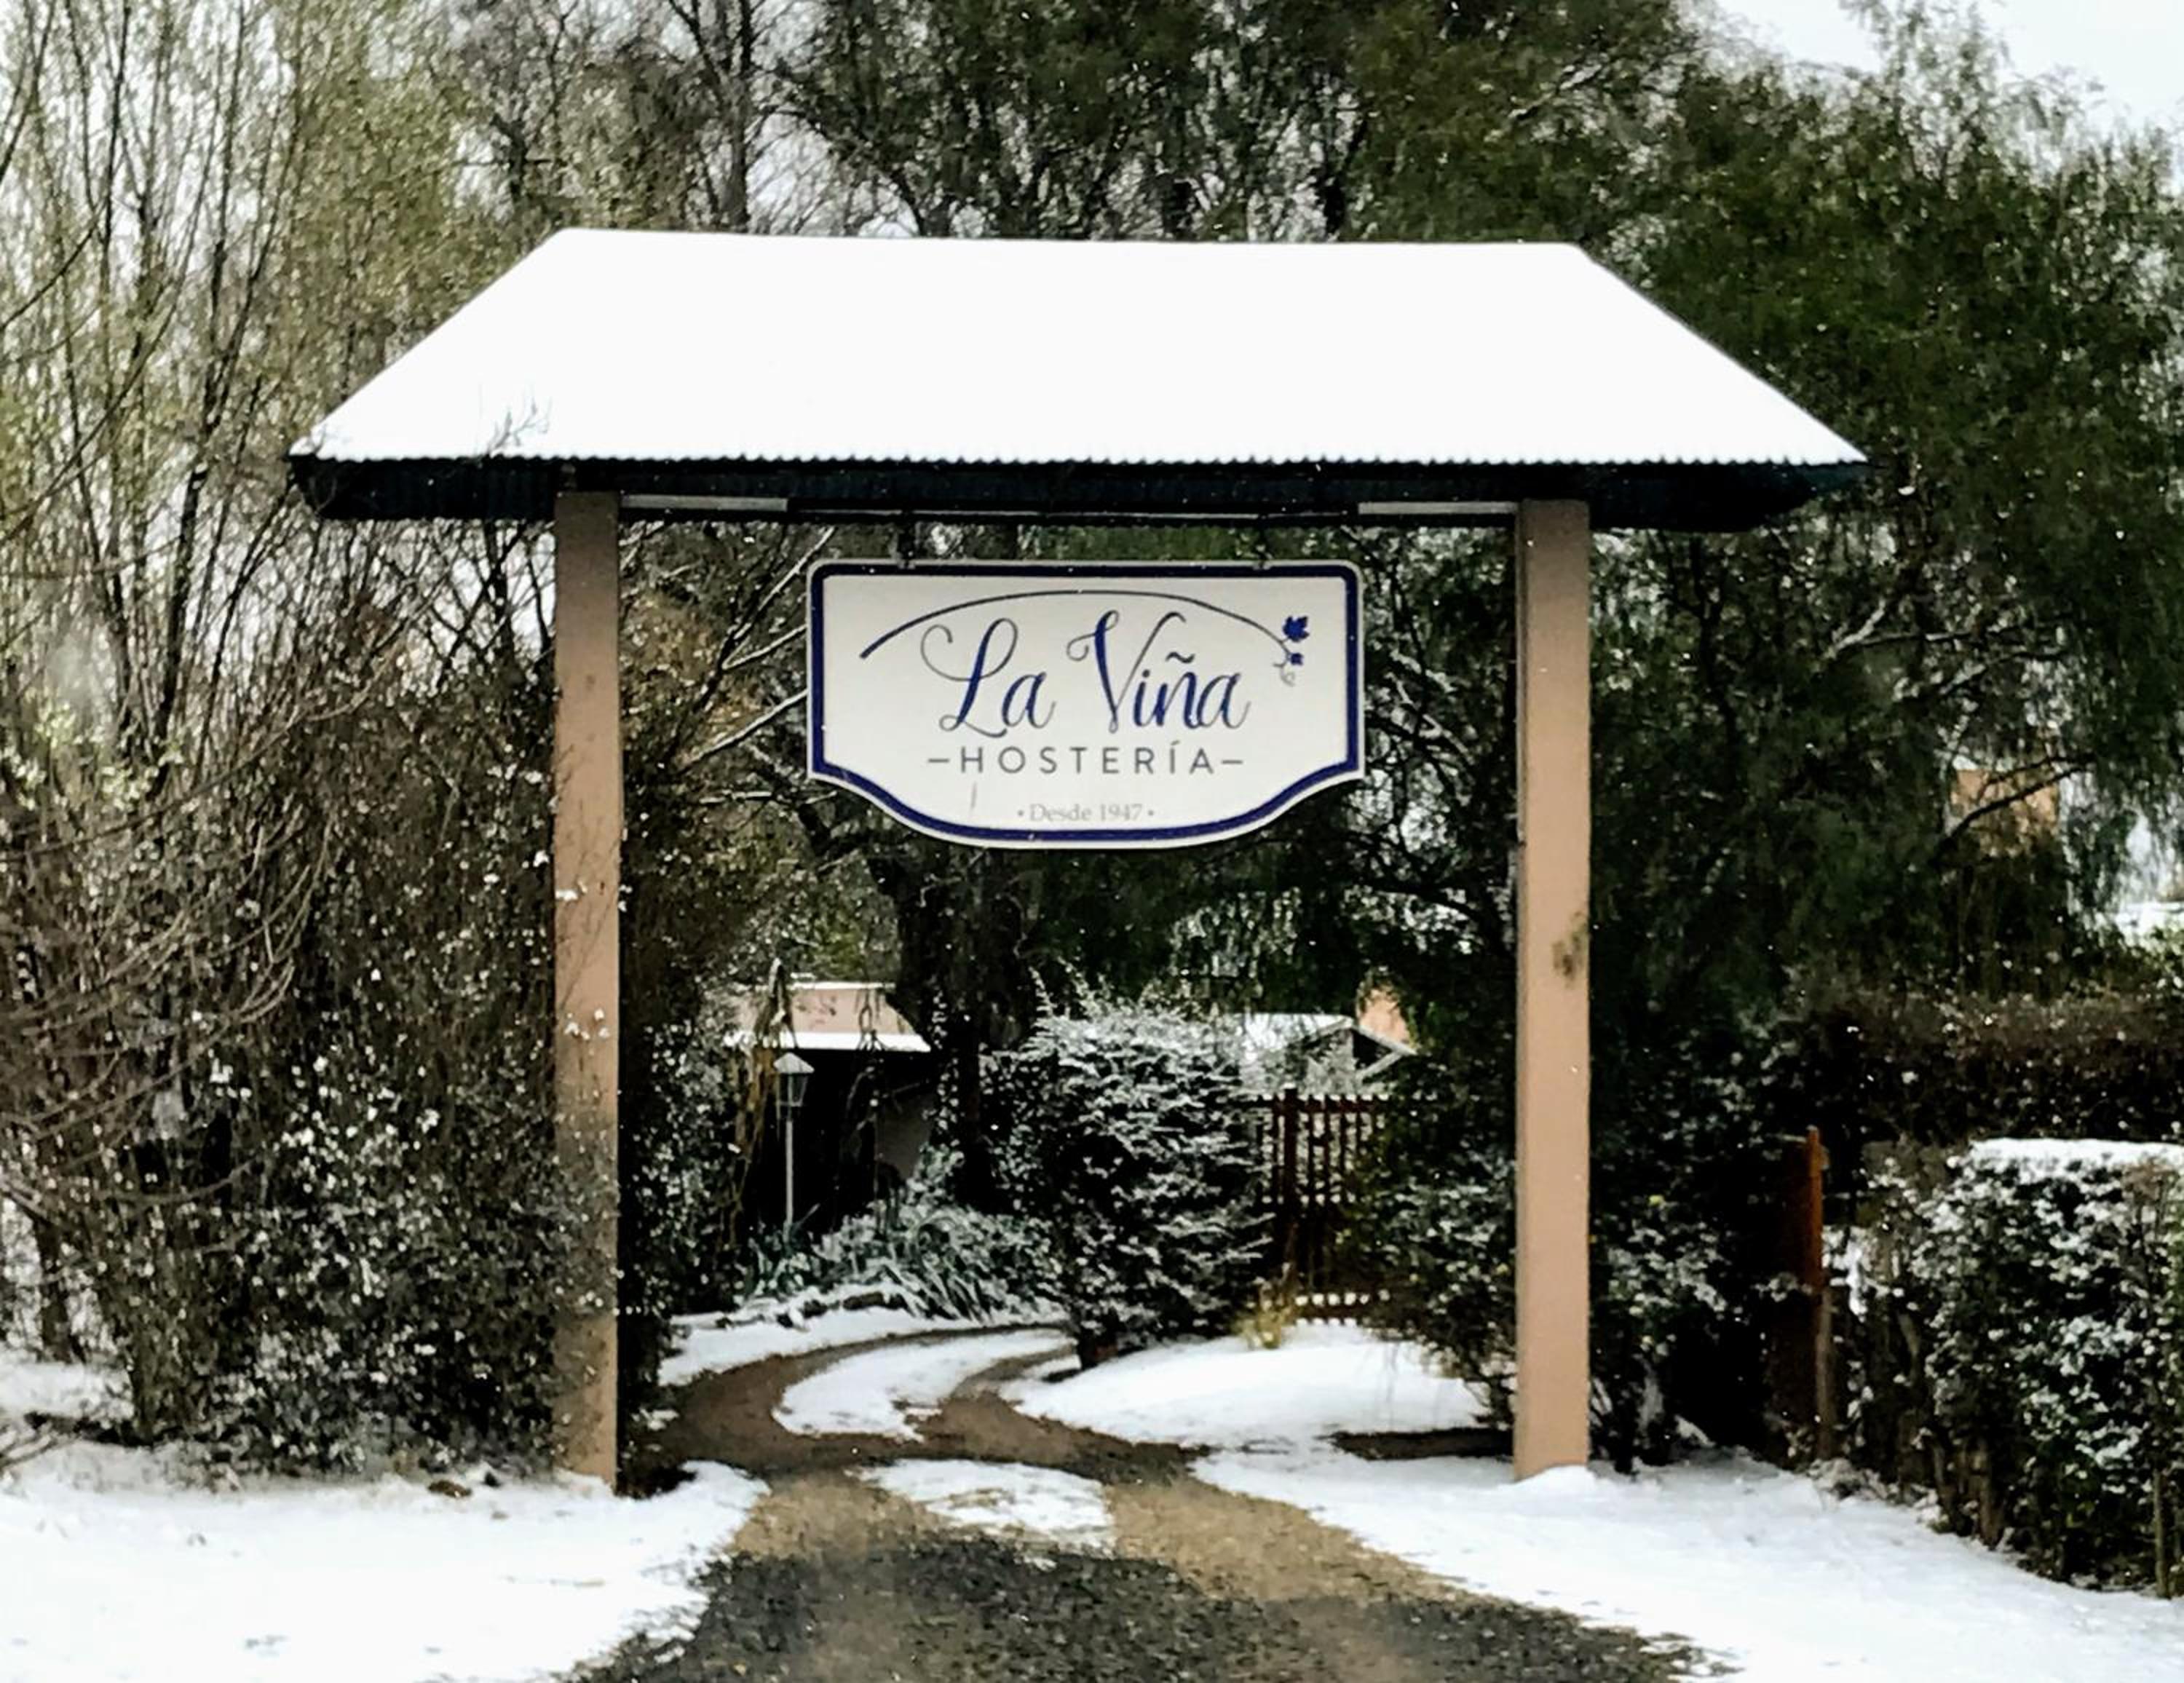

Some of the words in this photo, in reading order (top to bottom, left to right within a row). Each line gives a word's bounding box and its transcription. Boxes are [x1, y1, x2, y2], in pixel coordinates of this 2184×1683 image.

[920, 617, 1056, 738] La
[1066, 609, 1252, 733] Viña
[1029, 803, 1092, 822] Desde
[1100, 803, 1143, 822] 1947
